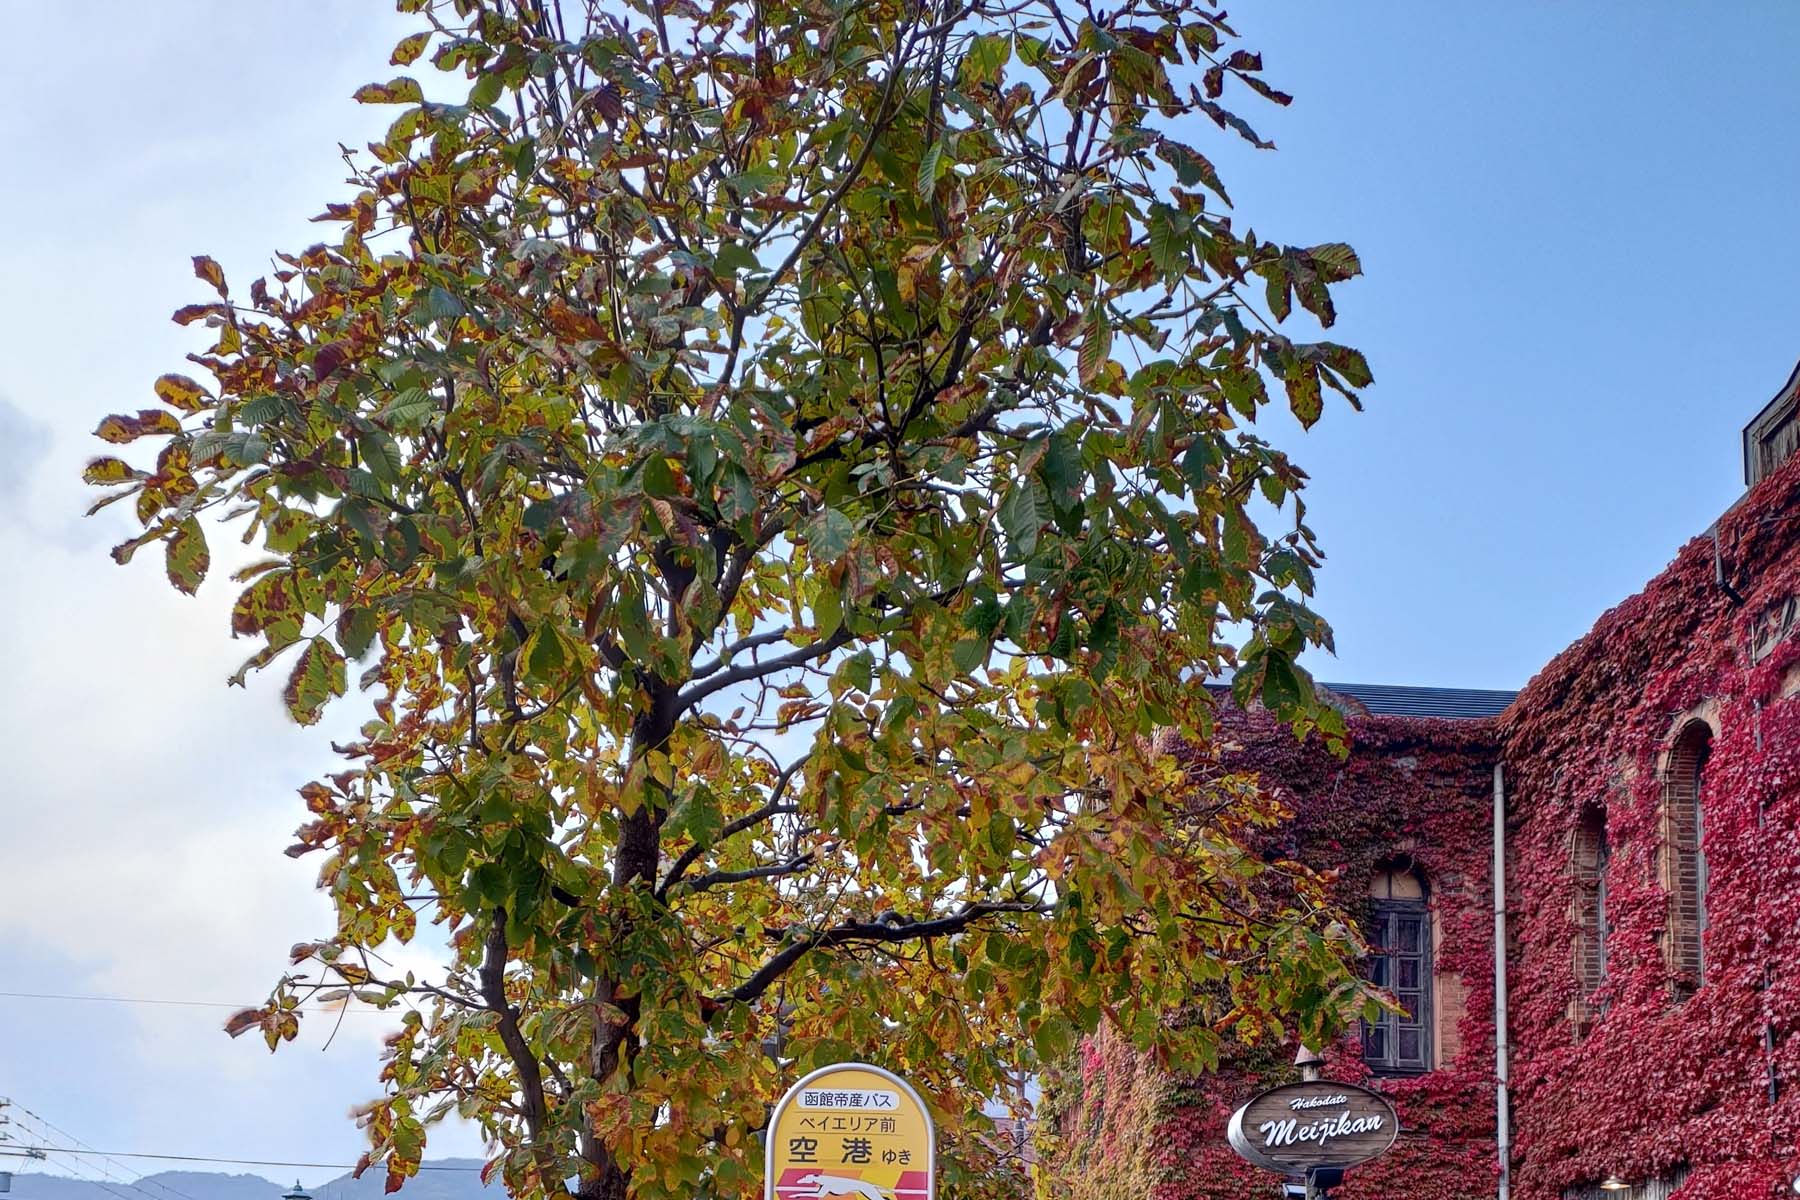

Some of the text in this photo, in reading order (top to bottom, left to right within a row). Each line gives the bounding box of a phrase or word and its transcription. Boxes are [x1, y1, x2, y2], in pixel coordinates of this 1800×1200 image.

[804, 1091, 892, 1108] 函館帝産バス
[1288, 1094, 1348, 1111] Hakodate
[800, 1116, 896, 1133] ベイエリア前
[1260, 1110, 1383, 1147] Meijikan
